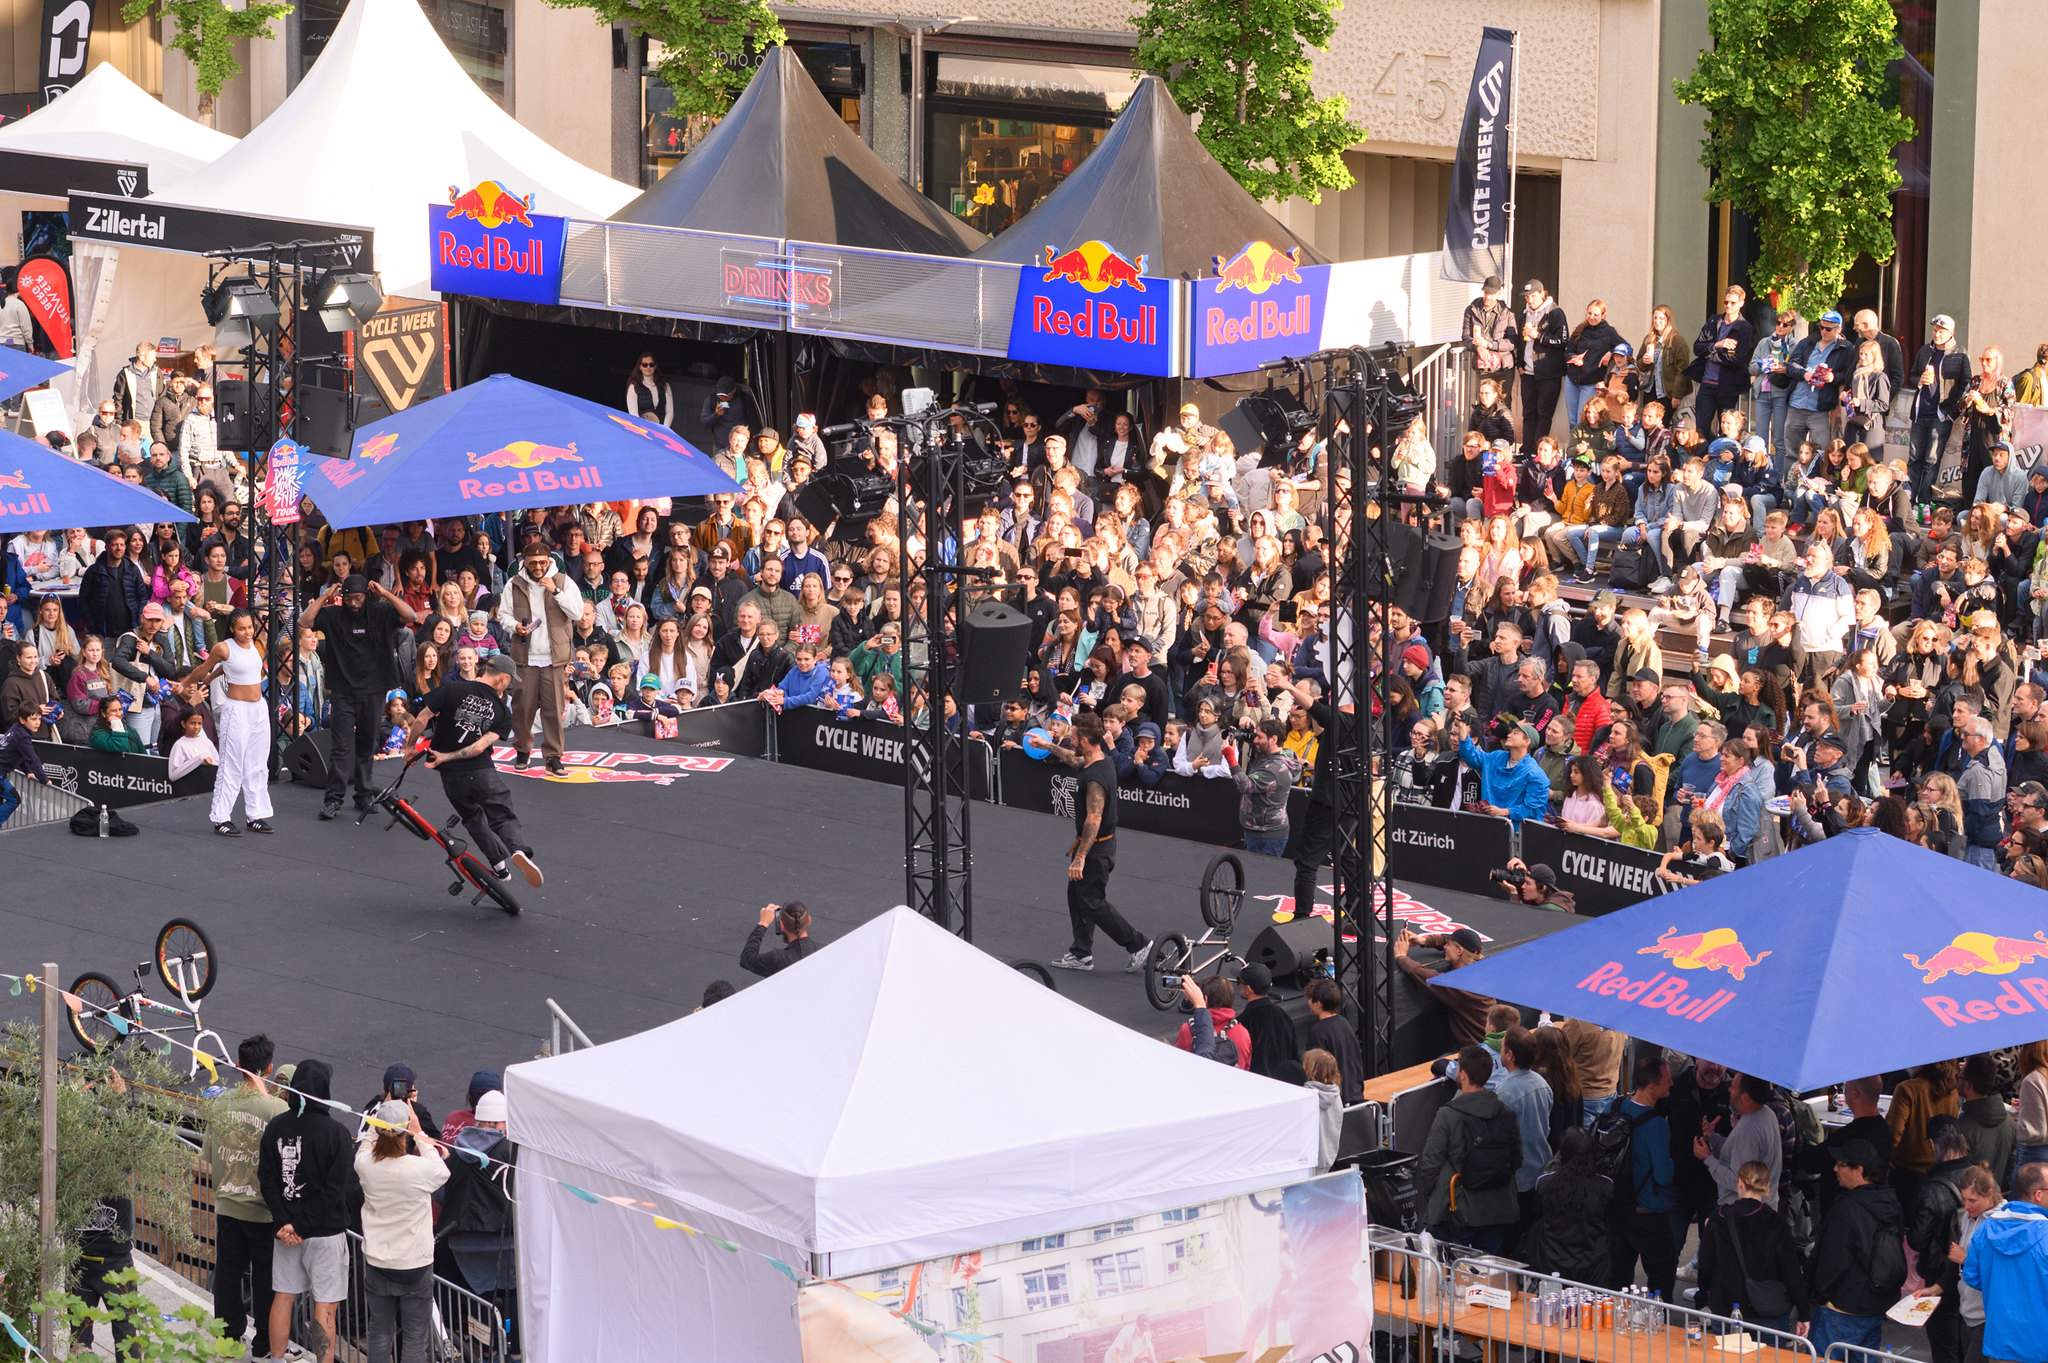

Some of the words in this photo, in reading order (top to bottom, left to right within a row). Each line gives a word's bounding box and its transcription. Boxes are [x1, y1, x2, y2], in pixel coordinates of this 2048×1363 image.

[1372, 52, 1452, 123] 45
[86, 207, 166, 240] Zillertal
[438, 230, 490, 269] Red
[493, 233, 544, 276] Bull
[723, 263, 832, 306] DRINKS
[362, 316, 398, 338] CYCLE
[401, 310, 437, 333] WEEK
[1033, 296, 1093, 338] Red
[1098, 301, 1157, 345] Bull
[1206, 302, 1257, 346] Red
[1261, 294, 1311, 340] Bull
[458, 471, 532, 500] Red
[533, 466, 603, 491] Bull
[606, 752, 736, 773] Red
[815, 724, 859, 754] CYCLE
[861, 734, 905, 764] WEEK
[88, 770, 124, 789] Stadt
[127, 775, 173, 795] Zürich
[1115, 785, 1144, 803] tadt
[1146, 789, 1190, 809] Zürich
[1409, 829, 1455, 850] Zürich
[1562, 849, 1606, 884] CYCLE
[1608, 861, 1654, 896] WEEK
[1575, 961, 1668, 1003] Red
[1638, 975, 1738, 1023] Bull
[1921, 980, 2037, 1028] Red
